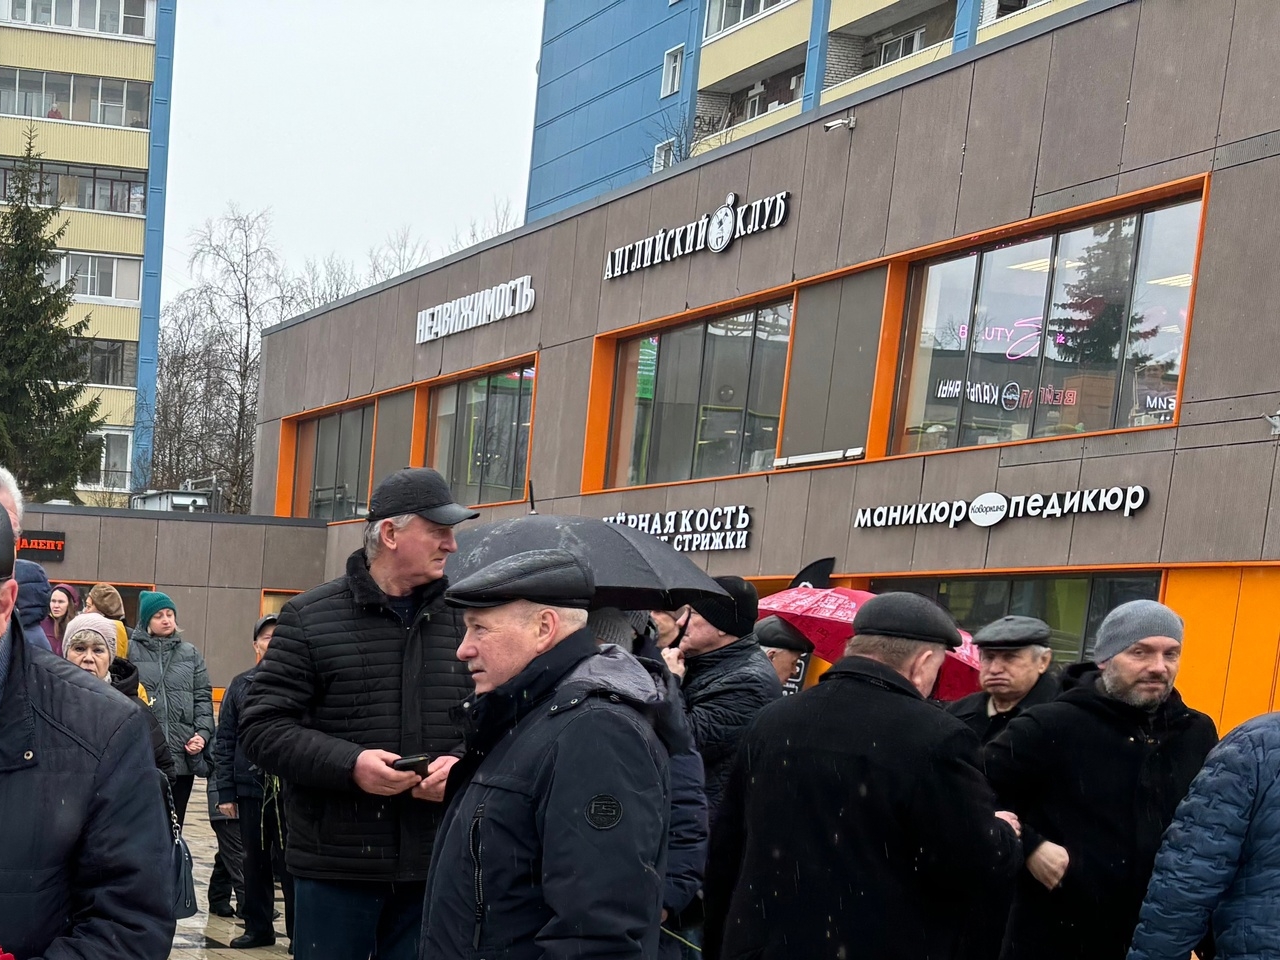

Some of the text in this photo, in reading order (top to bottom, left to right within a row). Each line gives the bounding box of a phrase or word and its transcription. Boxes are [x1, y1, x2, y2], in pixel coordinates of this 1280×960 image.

[603, 190, 787, 281] АНГЛИЙСКИЙ КЛУБ
[415, 274, 536, 345] НЕДВИЖИМОСТЬ
[958, 324, 1015, 343] BUTY
[853, 499, 967, 529] маникюр
[1008, 484, 1146, 519] педикюр
[679, 504, 750, 534] КОСТЬ
[673, 530, 749, 552] СТРИЖКИ
